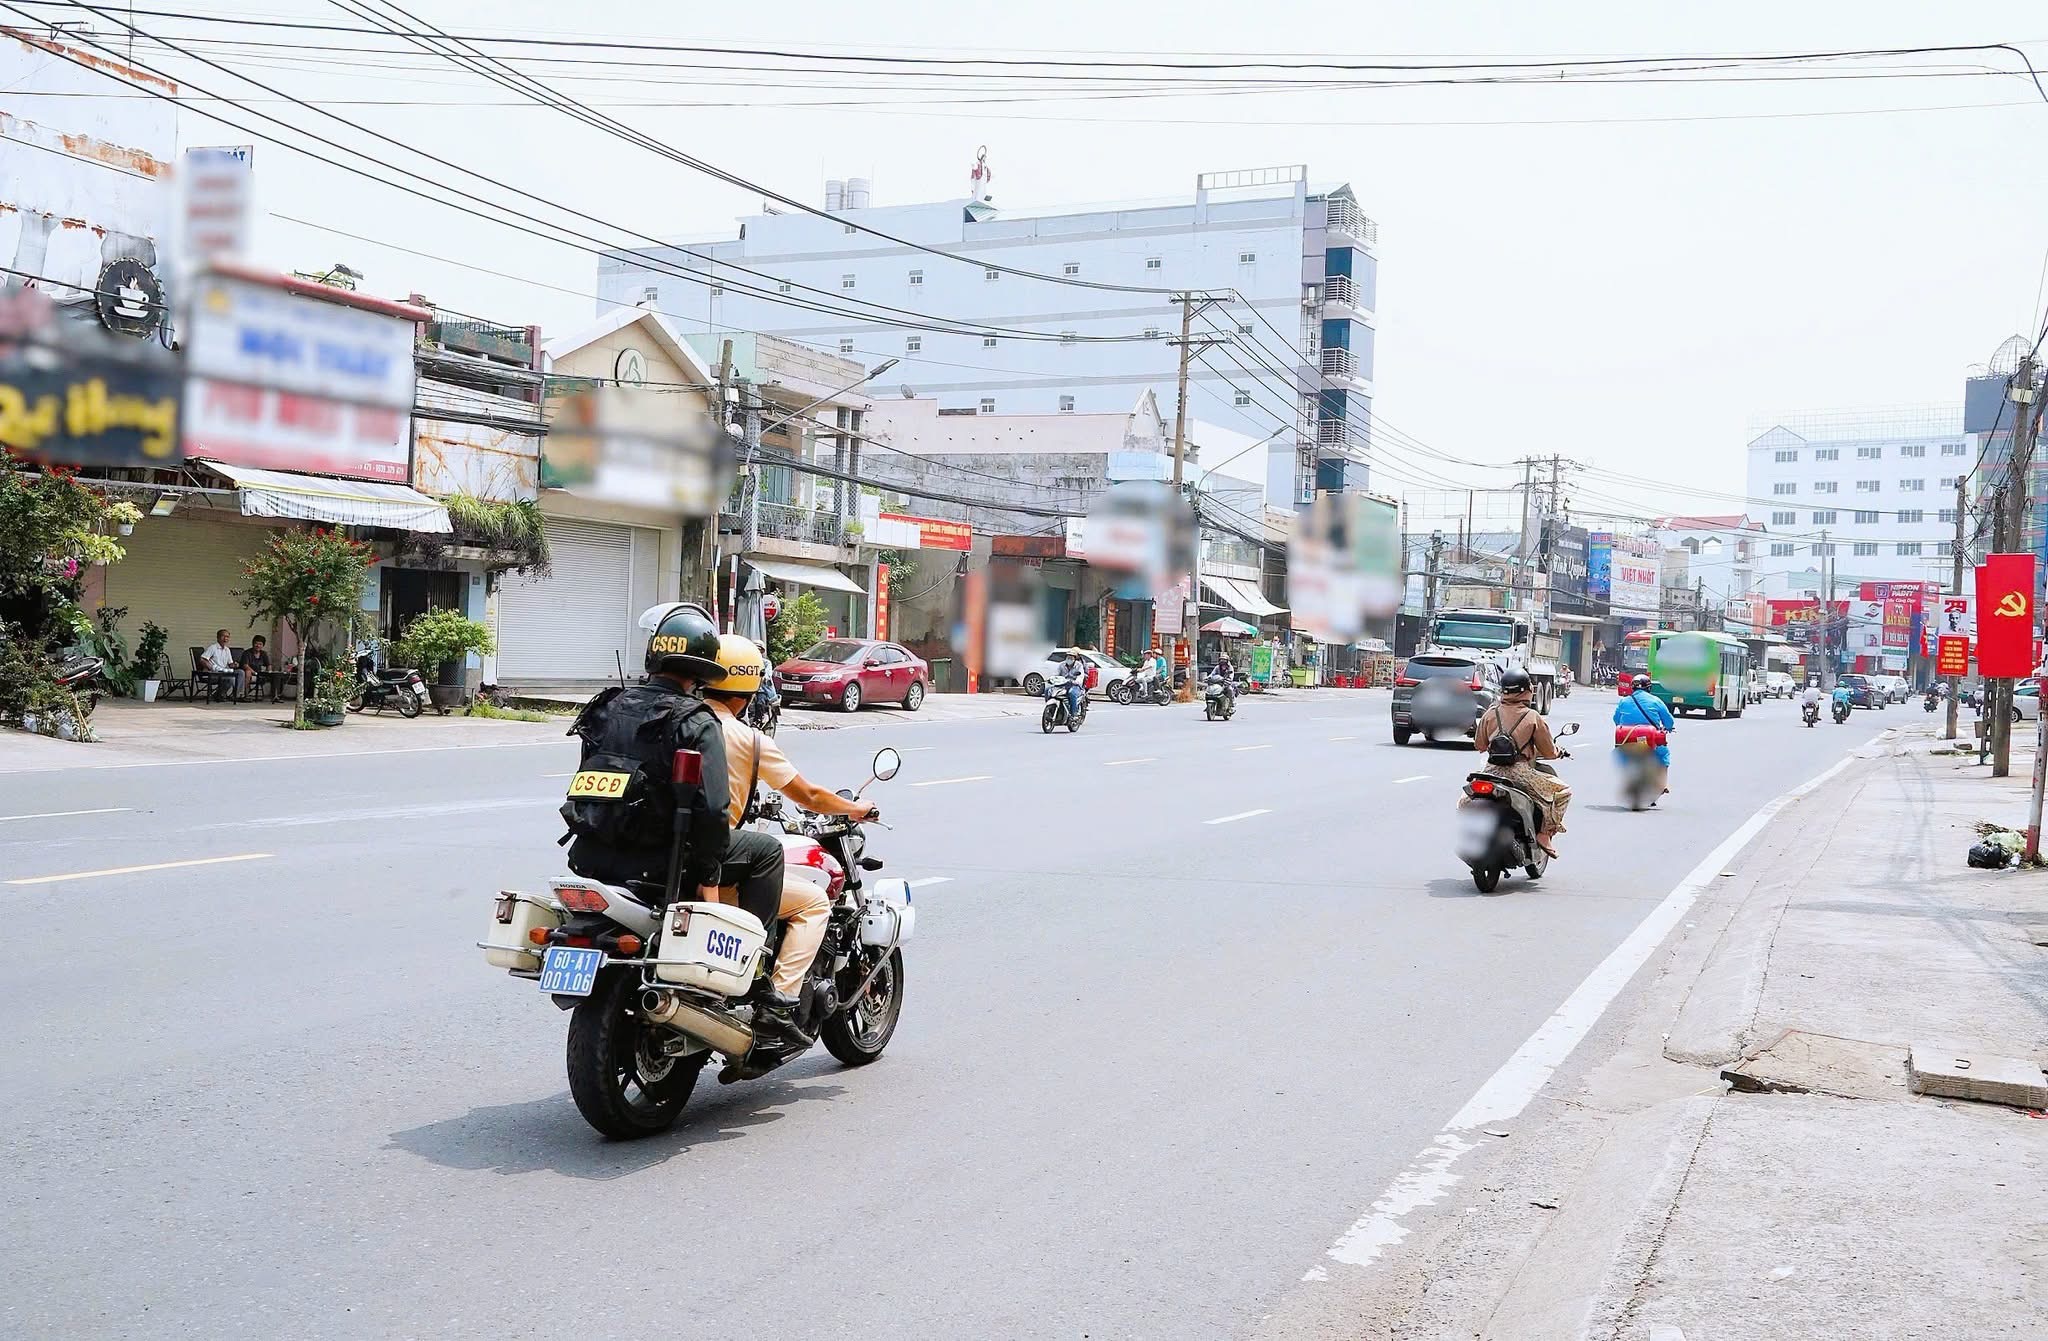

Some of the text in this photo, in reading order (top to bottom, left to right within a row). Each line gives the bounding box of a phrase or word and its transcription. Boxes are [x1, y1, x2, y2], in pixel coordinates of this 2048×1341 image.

[652, 636, 688, 654] CSCĐ
[728, 665, 760, 676] CSGT
[574, 775, 622, 793] CSCĐ
[706, 929, 743, 962] CSGT
[553, 950, 592, 971] 60-A1
[542, 971, 592, 993] 001.06
